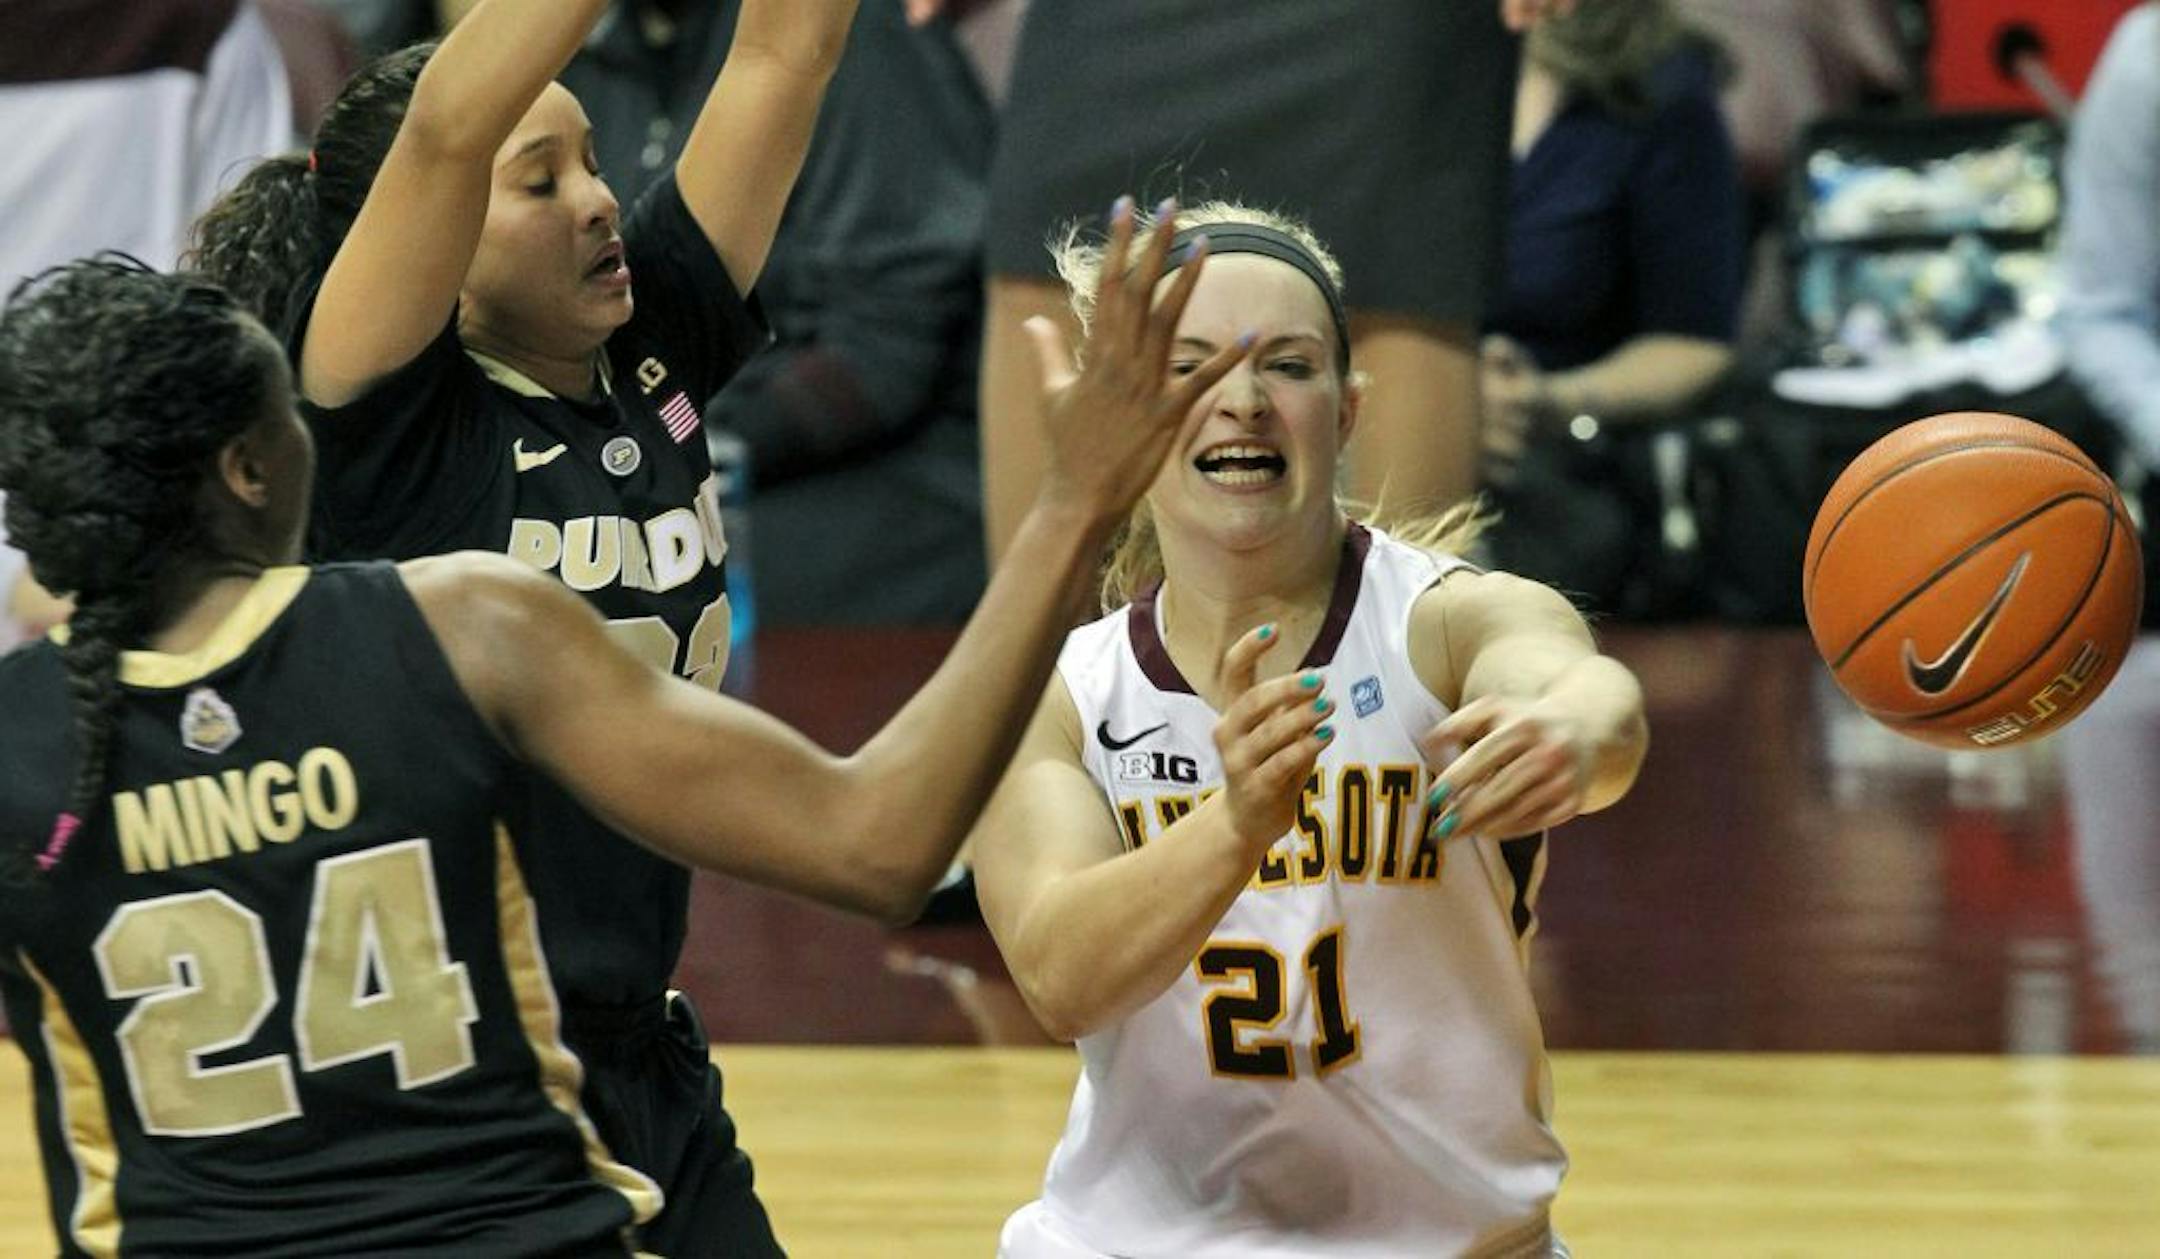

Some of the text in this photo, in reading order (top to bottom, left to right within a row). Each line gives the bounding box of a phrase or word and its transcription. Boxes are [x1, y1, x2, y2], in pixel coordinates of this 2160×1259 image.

[508, 471, 728, 593] PURDU
[113, 747, 359, 873] MINGO
[93, 838, 480, 1136] 24
[1194, 924, 1363, 1082] 21
